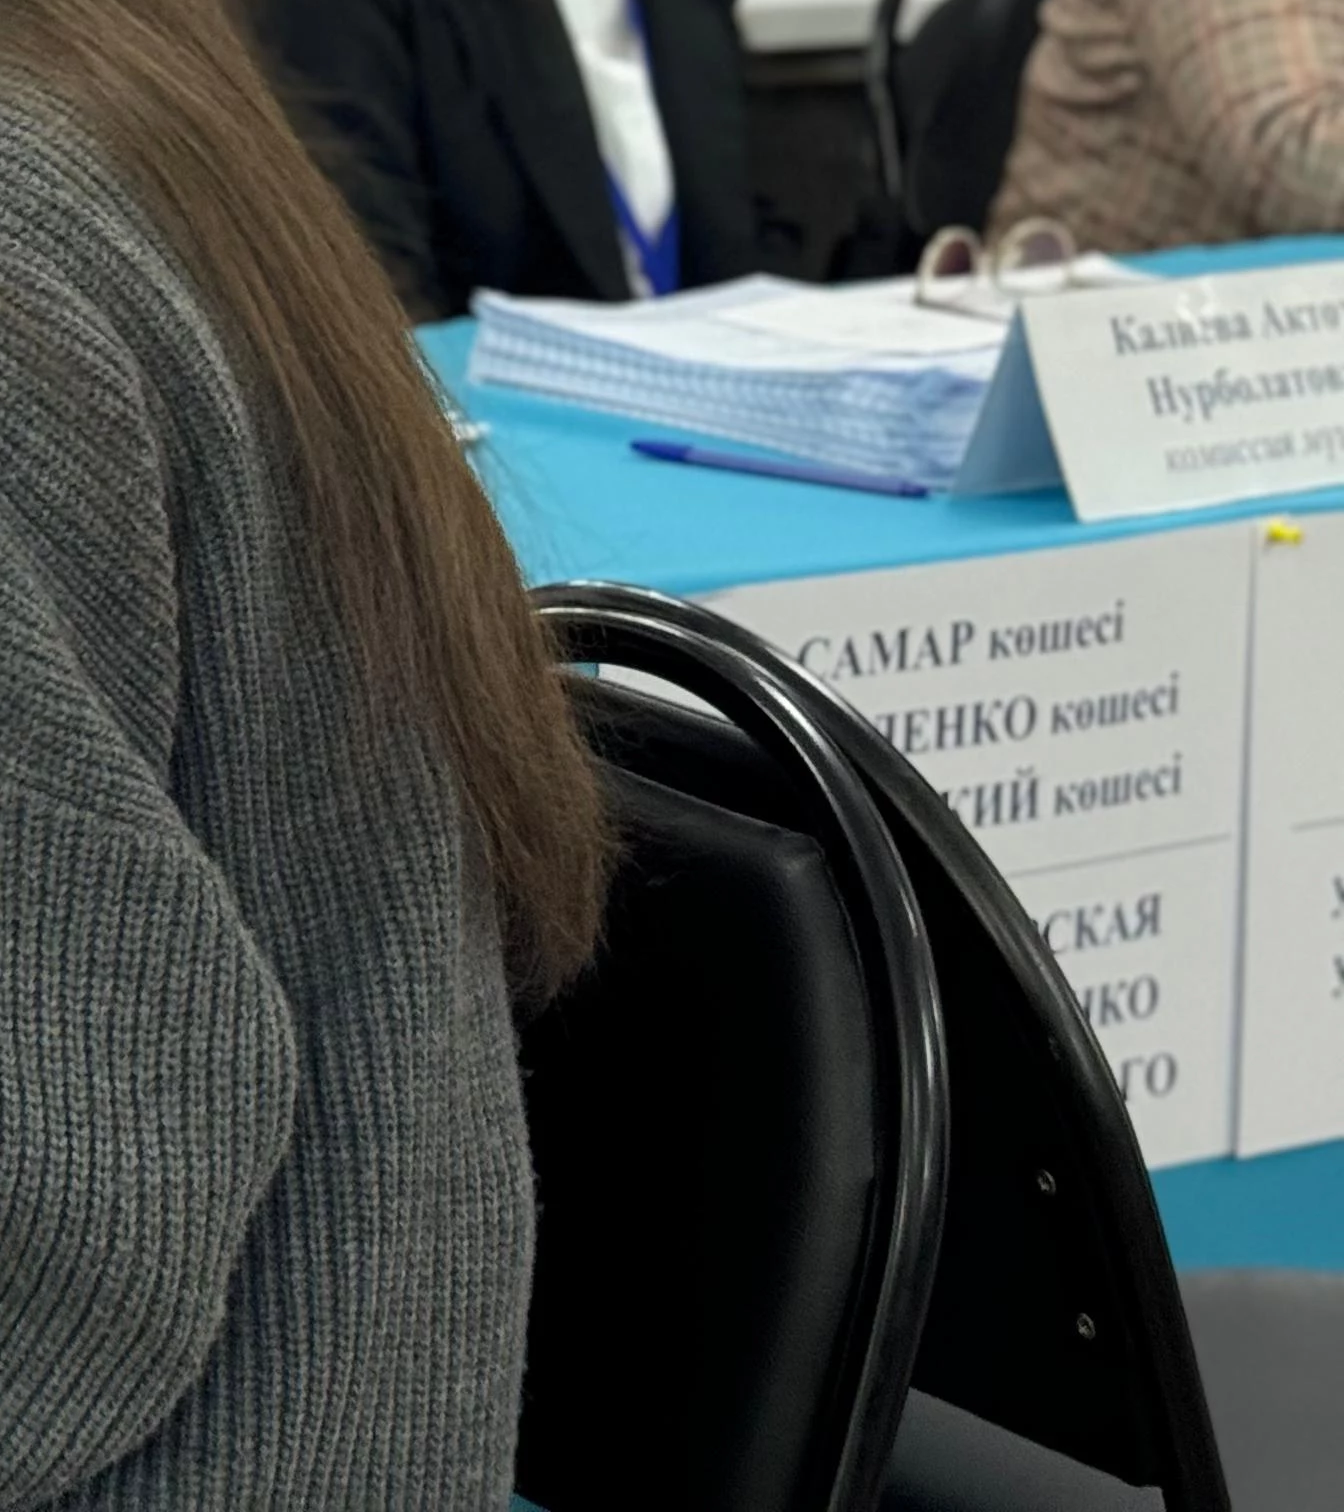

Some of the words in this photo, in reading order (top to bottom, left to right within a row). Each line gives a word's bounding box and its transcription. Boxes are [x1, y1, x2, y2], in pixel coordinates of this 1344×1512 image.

[1262, 300, 1344, 339] Акто
[1146, 364, 1344, 424] Нурболатов
[988, 599, 1125, 661] көшесі
[1050, 671, 1180, 736] көшесі
[1054, 751, 1183, 816] көшесі
